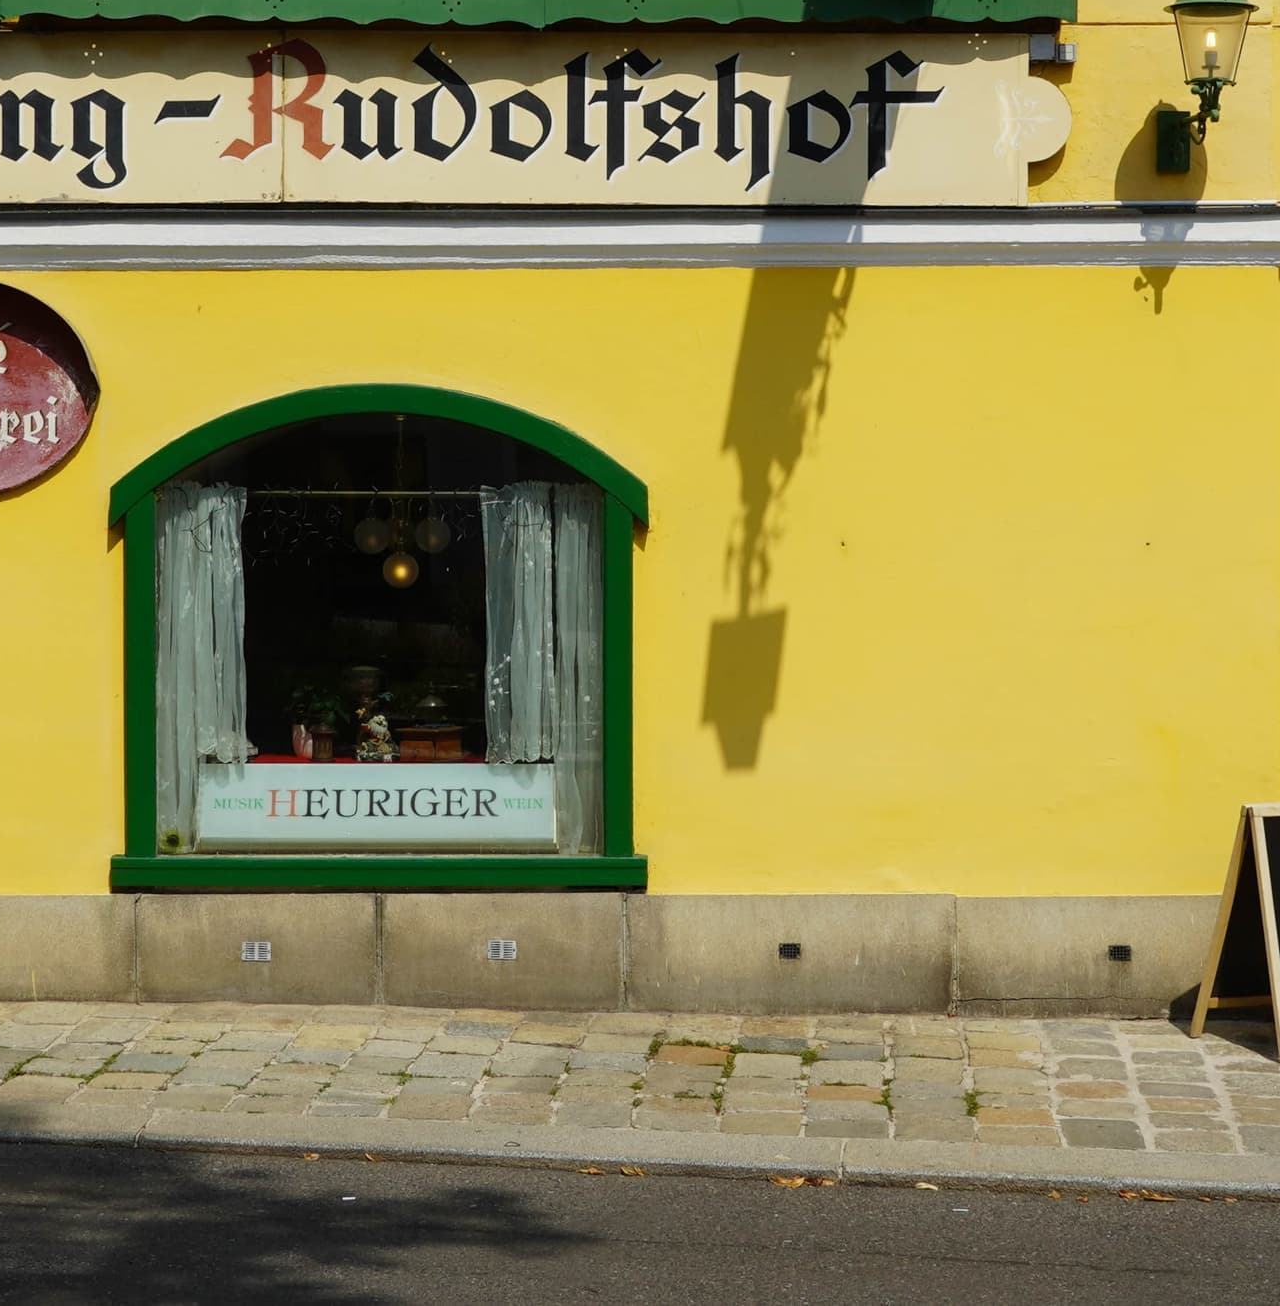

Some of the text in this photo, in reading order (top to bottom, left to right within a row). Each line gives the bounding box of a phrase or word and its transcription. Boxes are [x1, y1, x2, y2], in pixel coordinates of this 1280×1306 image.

[219, 36, 946, 192] Rudolfshof
[213, 787, 544, 820] MUSIK HEURIGER WEIN
